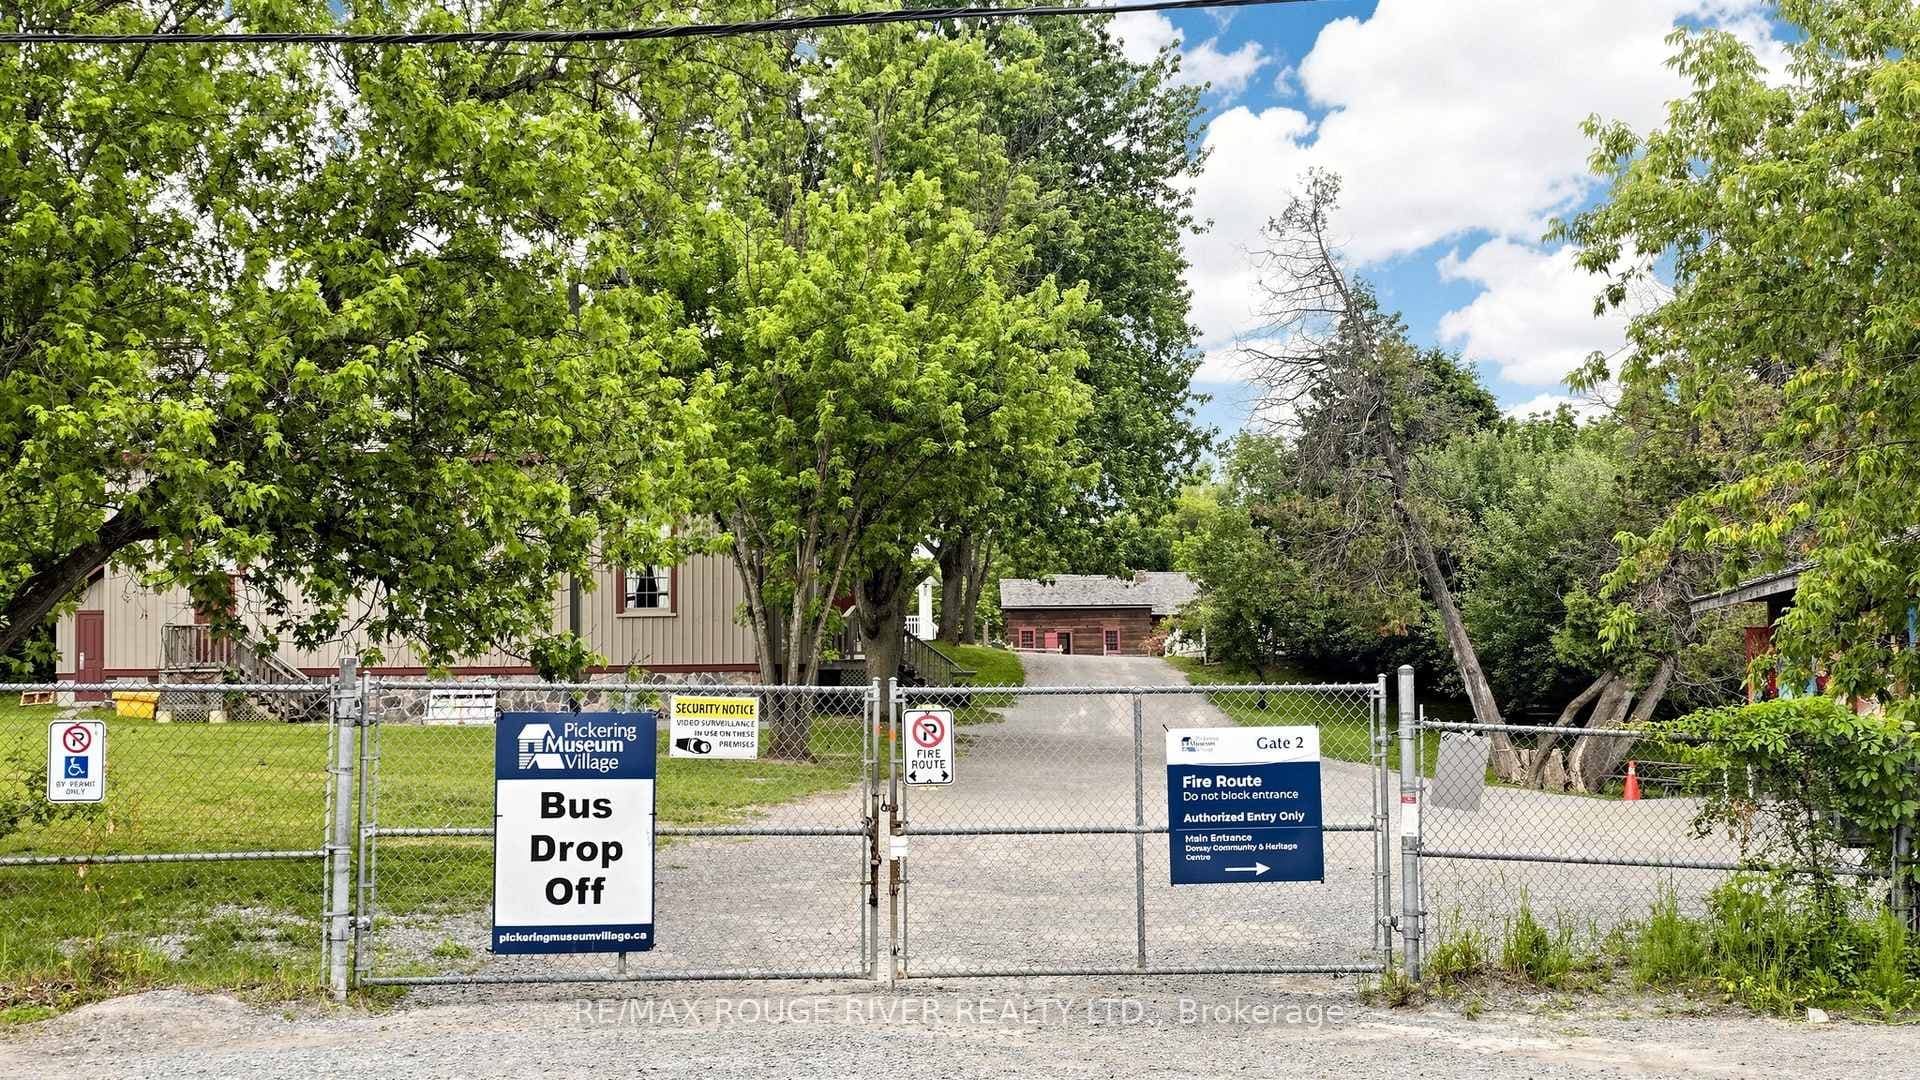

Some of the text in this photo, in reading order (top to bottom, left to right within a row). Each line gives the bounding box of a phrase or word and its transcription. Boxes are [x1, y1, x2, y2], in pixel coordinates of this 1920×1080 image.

[676, 703, 754, 714] SECURITY NOTICE
[676, 719, 755, 728] VIDEO SURVEILLANCE
[564, 721, 637, 741] Pickering
[733, 730, 755, 738] THESE
[545, 735, 624, 752] Museum
[719, 740, 755, 748] PREMISES
[1256, 736, 1304, 749] Gate 2
[916, 749, 941, 759] FIRE
[565, 753, 619, 773] Village
[911, 759, 947, 770] ROUTE
[70, 780, 96, 788] PERMIT
[1182, 774, 1262, 788] Fire Route
[1183, 790, 1299, 801] Do not block entrance
[541, 791, 613, 819] Bus
[1183, 810, 1305, 823] Authorized Entry Only
[1185, 833, 1253, 843] Main Entrance
[530, 834, 623, 868] Drop
[1212, 843, 1257, 852] Community
[1265, 842, 1298, 851] Heritage
[545, 877, 606, 906] Off
[499, 931, 647, 943] pickeringmuseumvillage.ca
